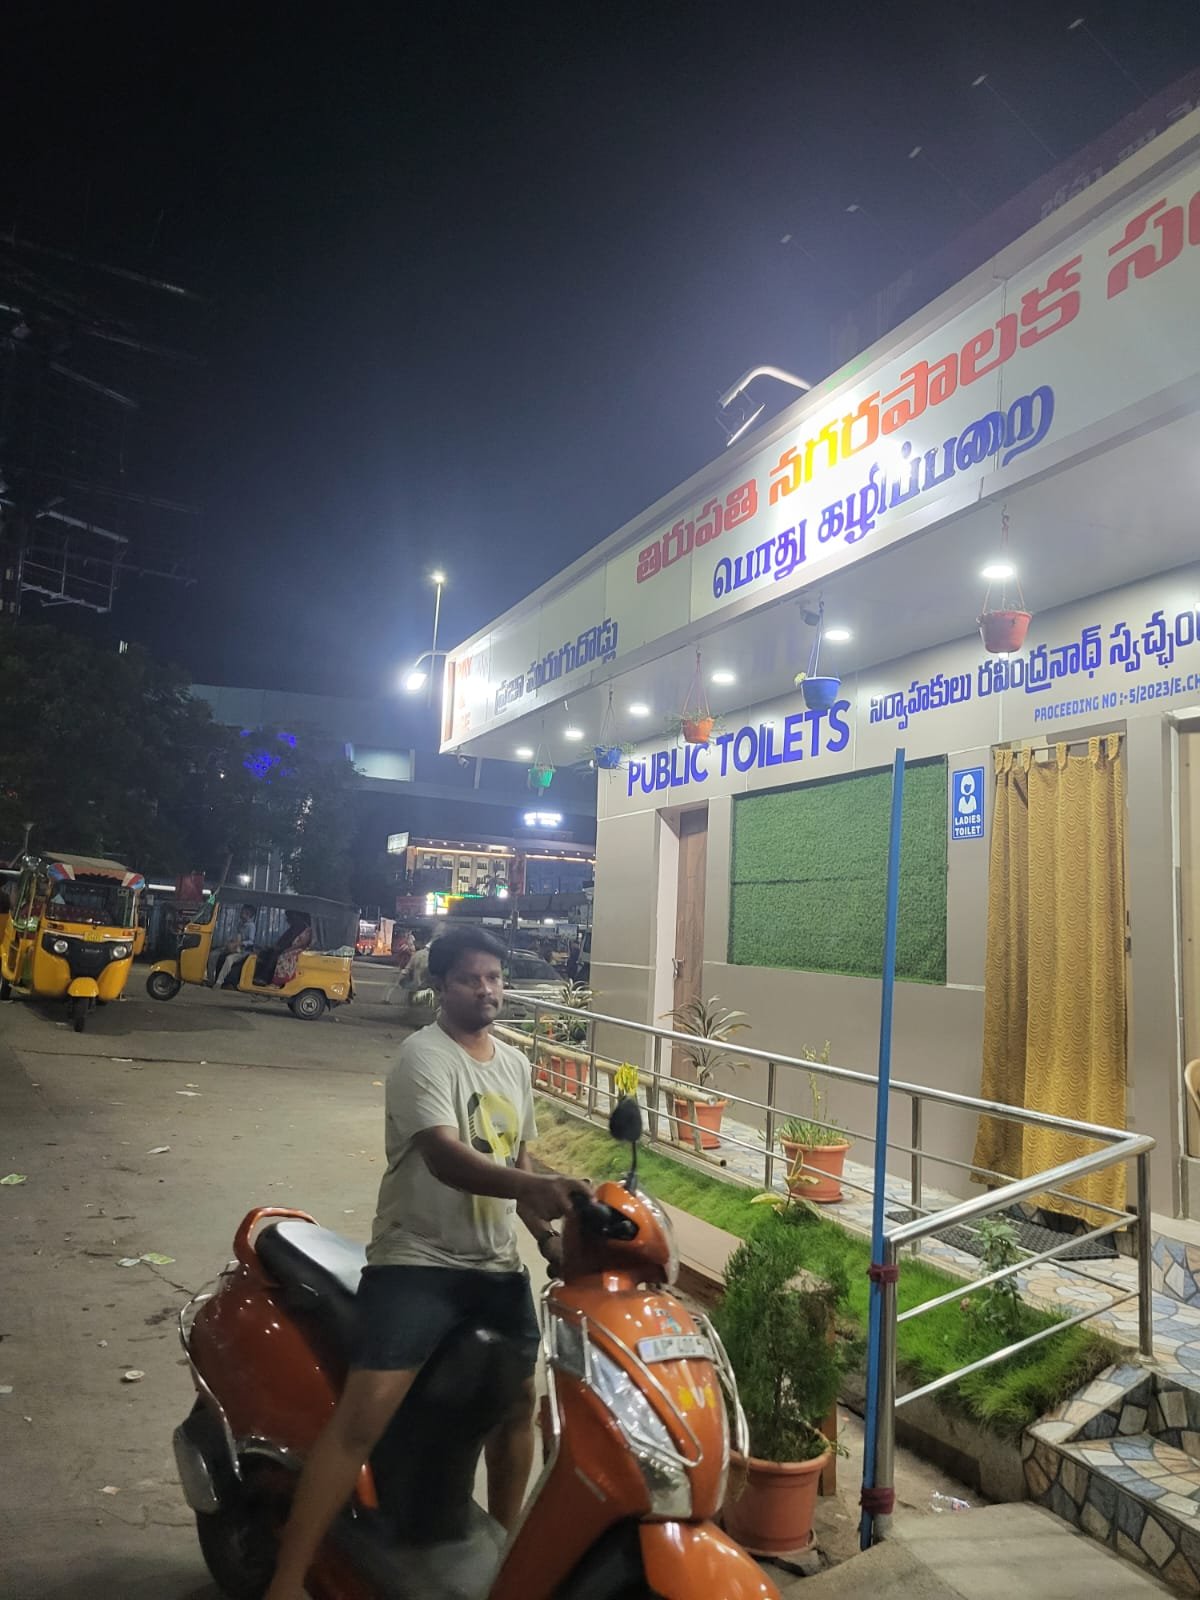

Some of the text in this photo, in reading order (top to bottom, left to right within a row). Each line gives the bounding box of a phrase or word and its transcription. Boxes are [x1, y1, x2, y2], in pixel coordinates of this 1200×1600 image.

[637, 479, 757, 584] తిరుపతి
[769, 254, 1082, 506] నగరపాలక
[713, 385, 1054, 599] பொது கழிப்பறை
[1109, 610, 1200, 673] స్వచ్ఛం
[1034, 696, 1099, 722] PROCEEDING
[627, 699, 851, 797] PUBLIC TOILETS
[955, 814, 981, 826] LADIES
[955, 825, 981, 837] TOILET
